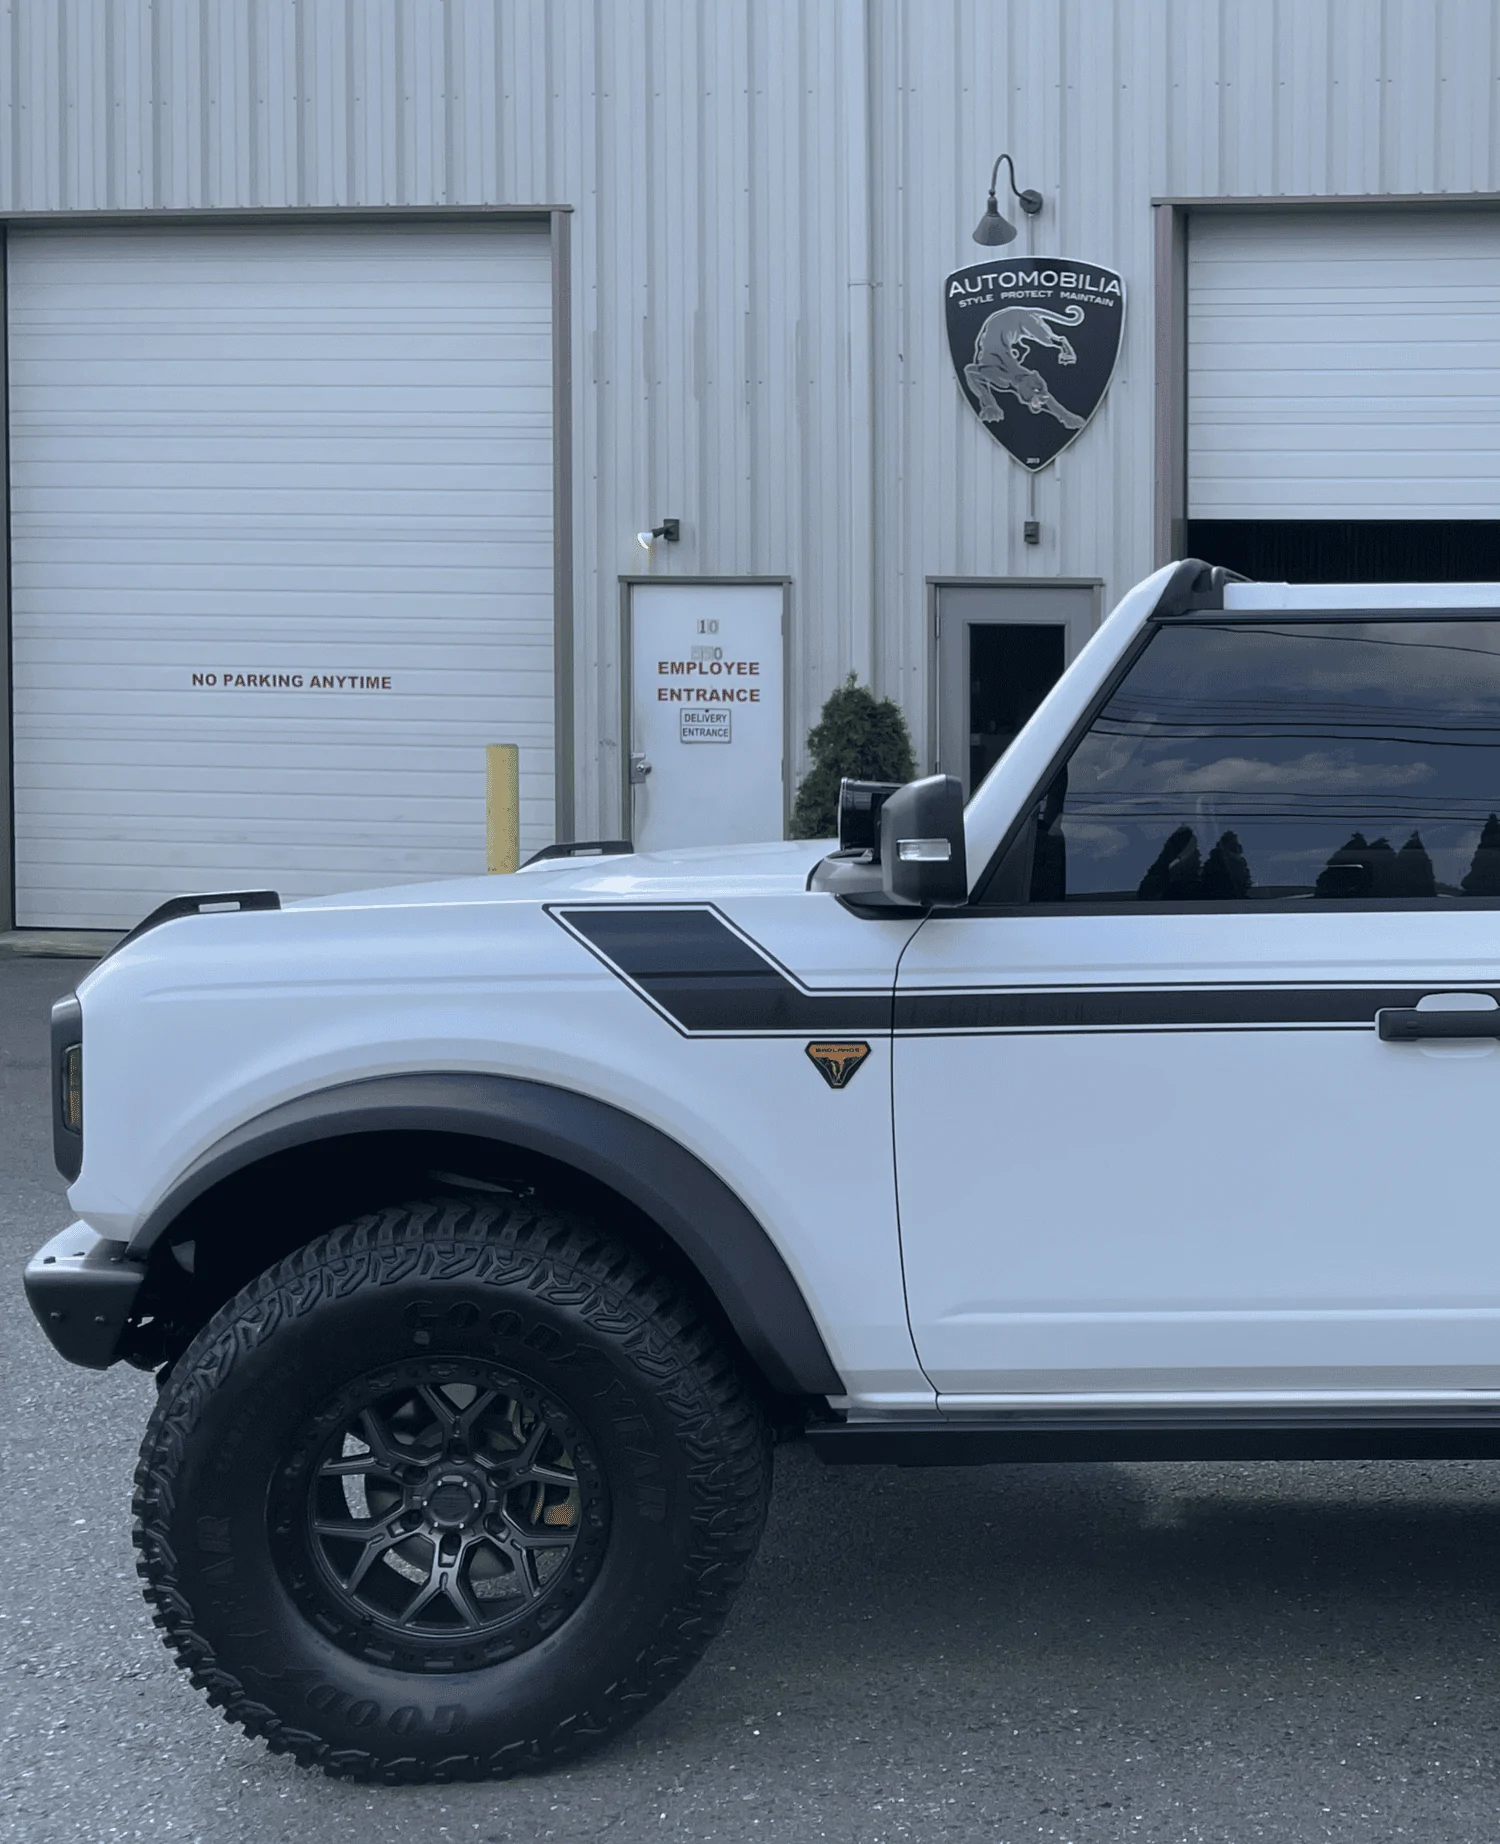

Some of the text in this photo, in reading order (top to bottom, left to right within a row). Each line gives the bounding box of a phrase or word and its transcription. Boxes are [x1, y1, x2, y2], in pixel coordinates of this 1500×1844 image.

[949, 271, 1121, 298] AUTOMOBILIA
[958, 290, 1114, 309] STYLE PROTECT MAINTAIN
[699, 619, 719, 634] 10
[657, 661, 760, 675] EMPLOYEE
[191, 673, 392, 690] NO PARKING ANYTIME
[657, 688, 761, 702] ENTRANCE
[684, 713, 727, 723] DELIVERY
[682, 728, 729, 738] ENTRANCE
